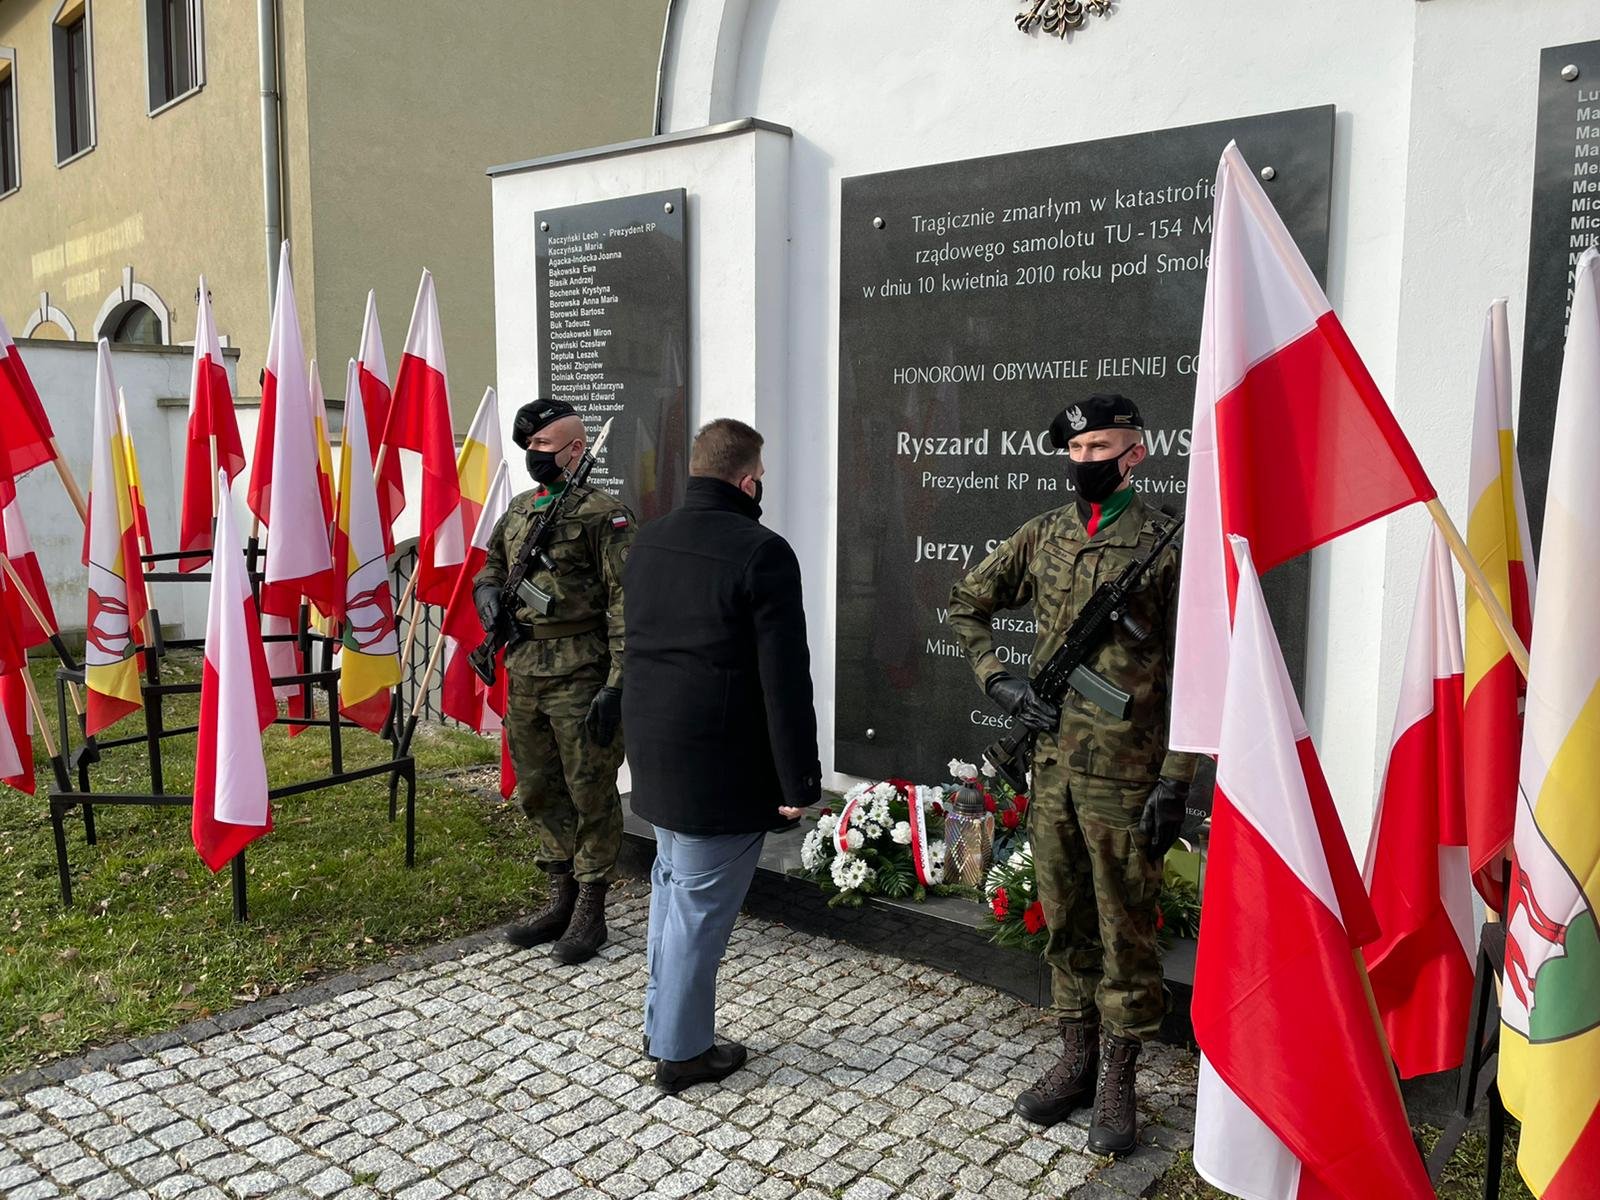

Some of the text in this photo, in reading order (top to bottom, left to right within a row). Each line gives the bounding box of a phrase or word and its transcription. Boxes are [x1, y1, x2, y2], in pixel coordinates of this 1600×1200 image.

[911, 207, 995, 236] Tragicznie
[1002, 197, 1081, 223] zmarłym
[1090, 197, 1106, 212] w
[548, 232, 581, 245] Kaczyński
[582, 230, 599, 241] Lech
[609, 224, 645, 238] Prezydent
[645, 222, 657, 232] RP
[584, 242, 603, 251] Maria
[915, 242, 1005, 266] rządowego
[1012, 229, 1095, 254] samolotu
[598, 250, 622, 261] Joanna
[582, 264, 597, 273] Ewa
[569, 275, 594, 286] Andrzej
[862, 284, 876, 299] w
[880, 278, 912, 297] dniu
[917, 276, 935, 294] 10
[942, 268, 1009, 292] kwietnia
[1016, 264, 1055, 286] 2010
[1062, 259, 1102, 281] roku
[1111, 253, 1147, 284] pod
[549, 285, 611, 298] Bochenek Krystyna
[549, 294, 619, 309] Borowska Anna Maria
[549, 307, 605, 319] Borowski Bartosz
[550, 320, 590, 329] Buk Tadeusz
[550, 328, 612, 340] Chodakowski Miron
[576, 350, 599, 359] Leszek
[574, 361, 603, 371] Zbigniew
[893, 364, 985, 385] HONOROWI
[992, 359, 1089, 382] OBYWATELE
[1095, 356, 1167, 381] JELENIEJ
[551, 372, 604, 382] Dolniak Grzegorz
[592, 382, 624, 391] Katarzyna
[590, 392, 615, 401] Edward
[588, 402, 625, 412] Aleksander
[896, 428, 989, 463] Ryszard
[921, 470, 1000, 494] Prezydent
[1007, 472, 1030, 490] RP
[1036, 477, 1057, 491] na
[914, 535, 974, 570] Jerzy
[970, 709, 1014, 730] Cześć
[1185, 807, 1207, 818] IEGO
